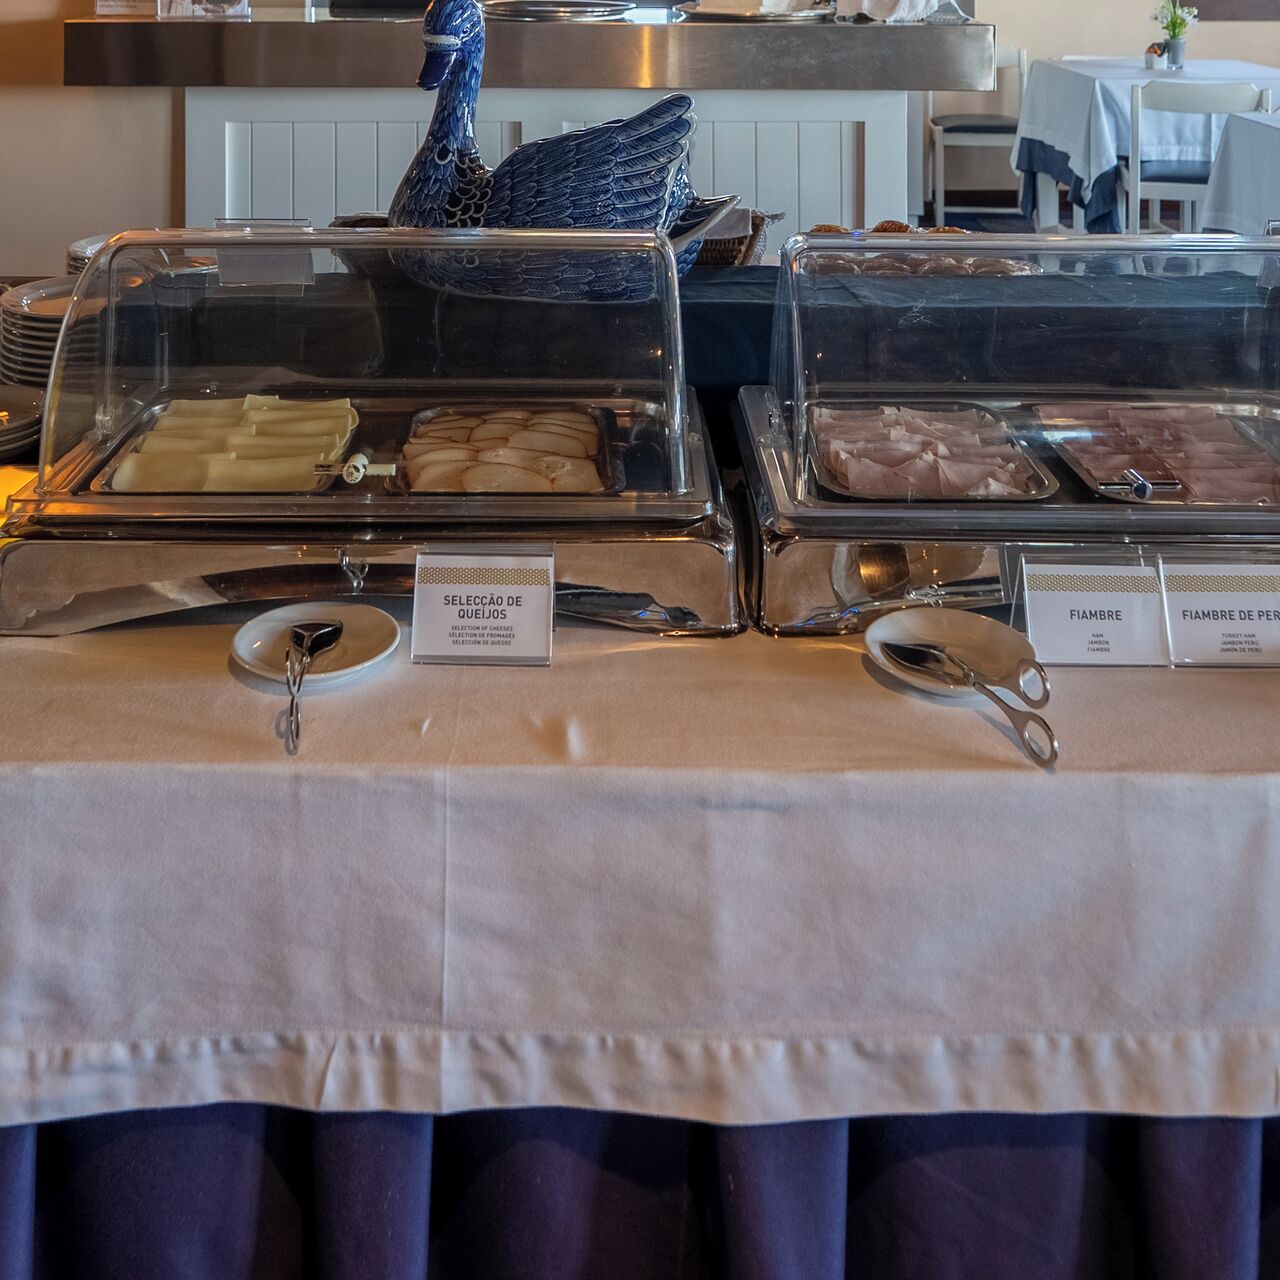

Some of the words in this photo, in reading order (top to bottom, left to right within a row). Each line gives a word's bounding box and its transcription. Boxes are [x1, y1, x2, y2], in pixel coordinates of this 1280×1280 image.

[444, 593, 503, 608] SELECÇÃO
[507, 596, 522, 607] DE
[458, 608, 507, 620] QUEIJOS
[1070, 609, 1122, 621] FIAMBRE
[1182, 609, 1236, 621] FIAMBRE
[1239, 609, 1254, 621] DE
